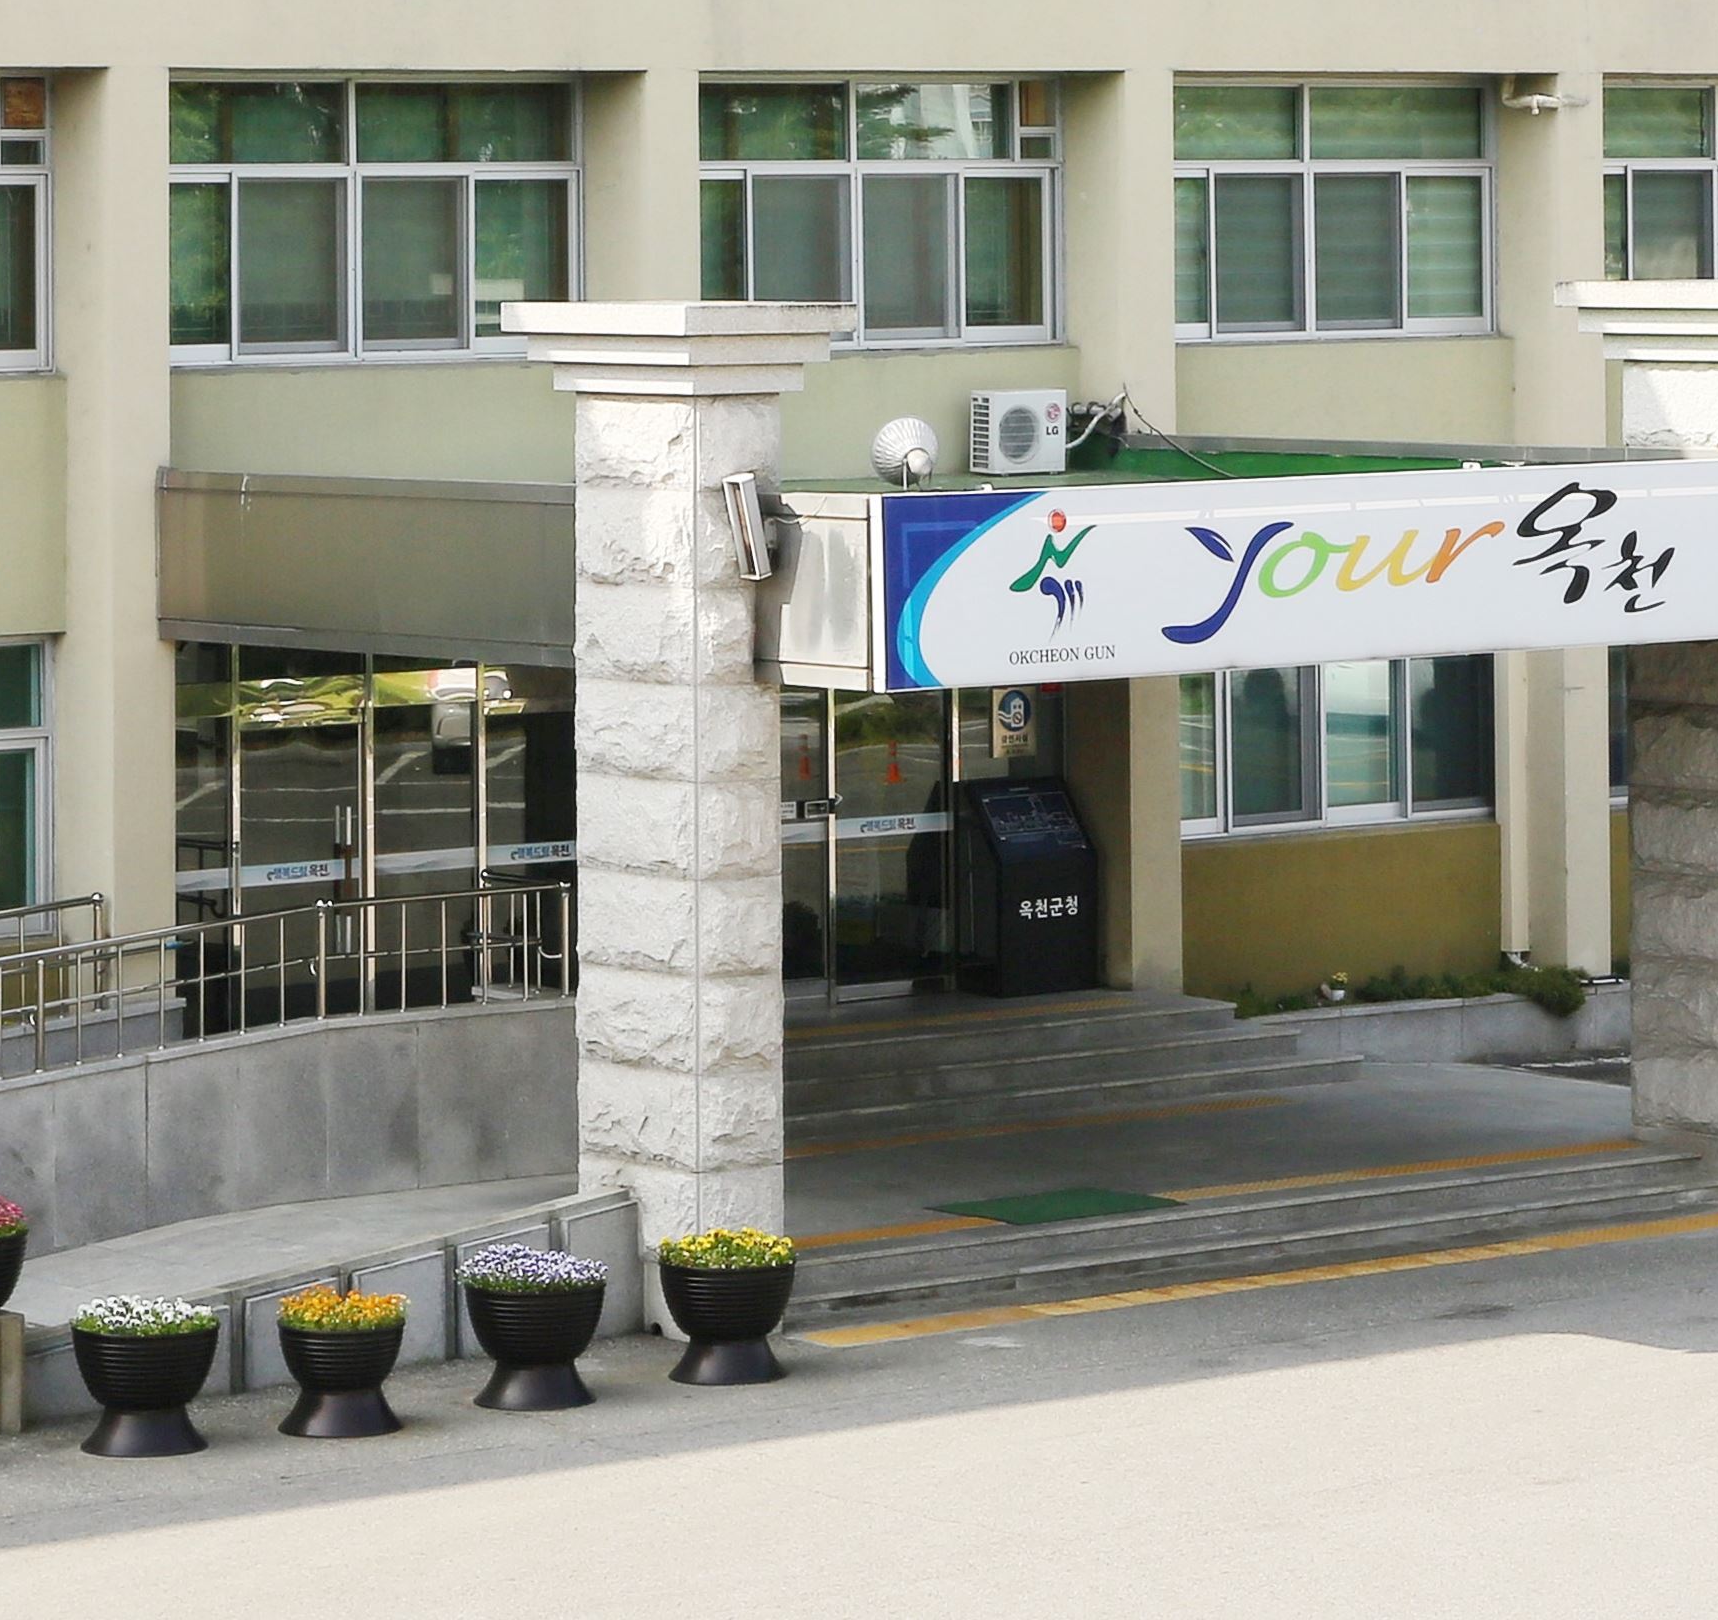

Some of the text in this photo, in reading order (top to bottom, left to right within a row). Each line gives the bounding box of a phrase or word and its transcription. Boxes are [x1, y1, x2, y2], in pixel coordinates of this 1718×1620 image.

[1046, 425, 1059, 436] LG
[1161, 482, 1676, 645] your 옥천
[1009, 644, 1116, 666] OKCHEON GUN
[1019, 895, 1079, 920] 옥천군청
